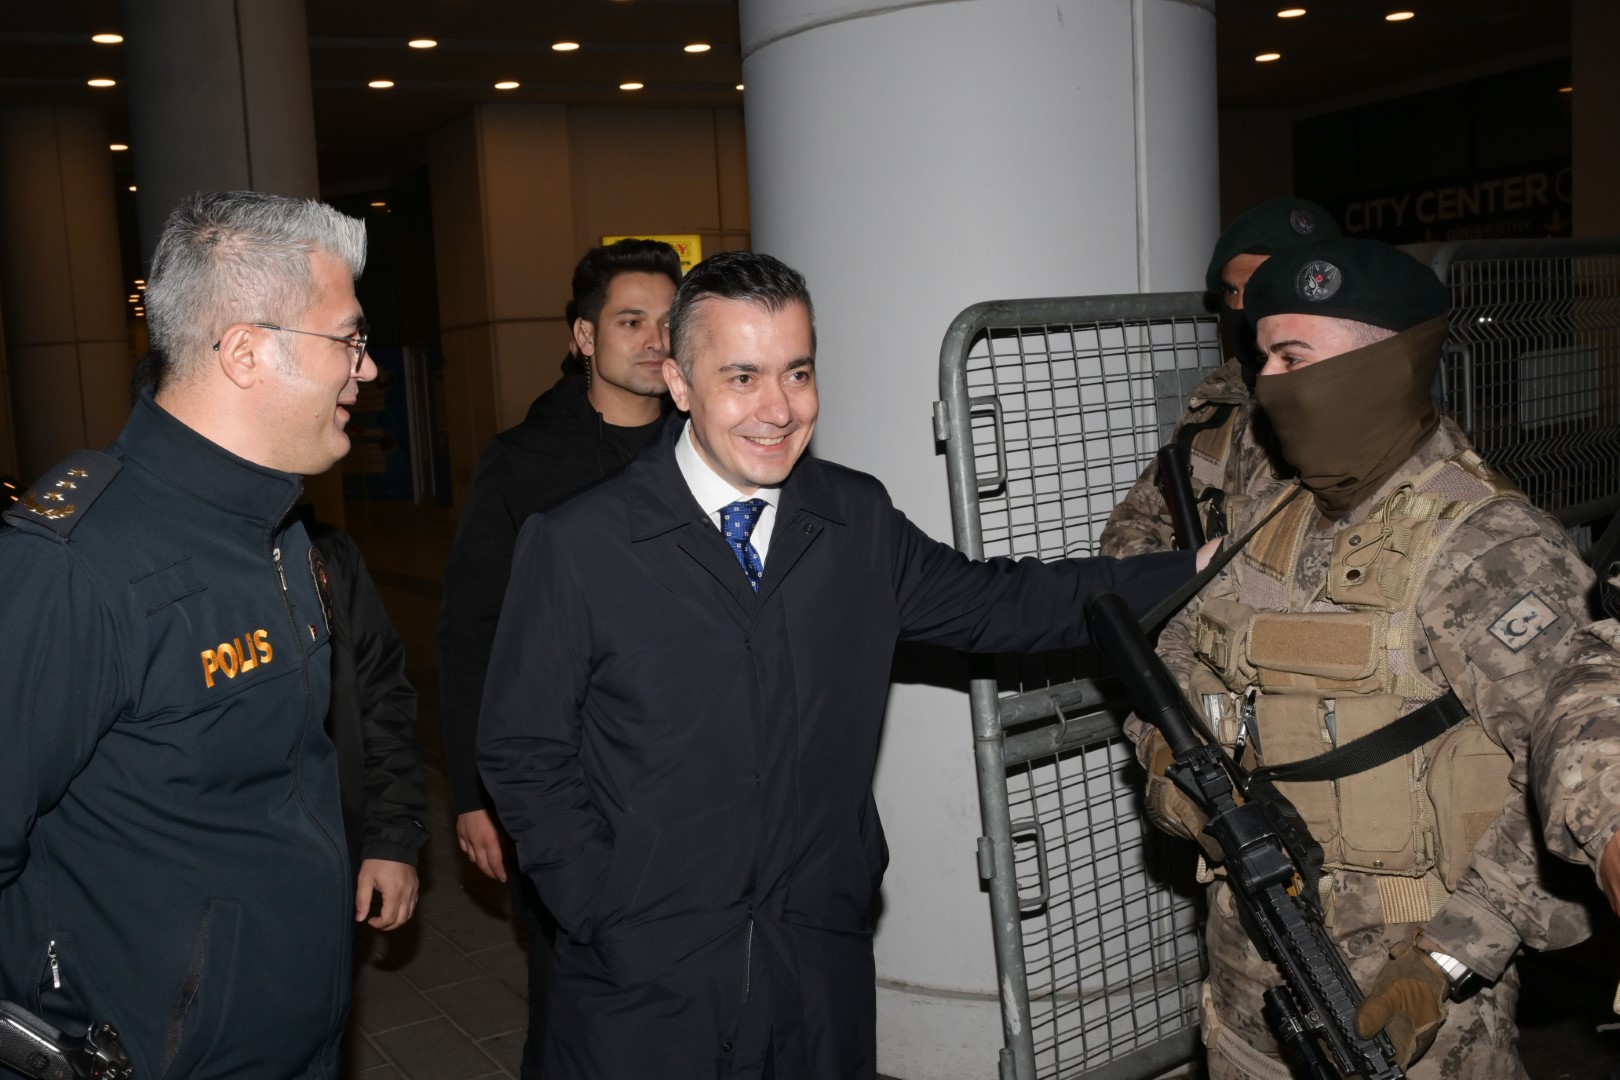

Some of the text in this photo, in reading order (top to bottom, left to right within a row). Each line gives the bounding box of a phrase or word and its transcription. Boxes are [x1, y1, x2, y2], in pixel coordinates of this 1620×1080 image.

[1344, 172, 1549, 233] CITY CENTER
[1487, 219, 1533, 238] ENTRY
